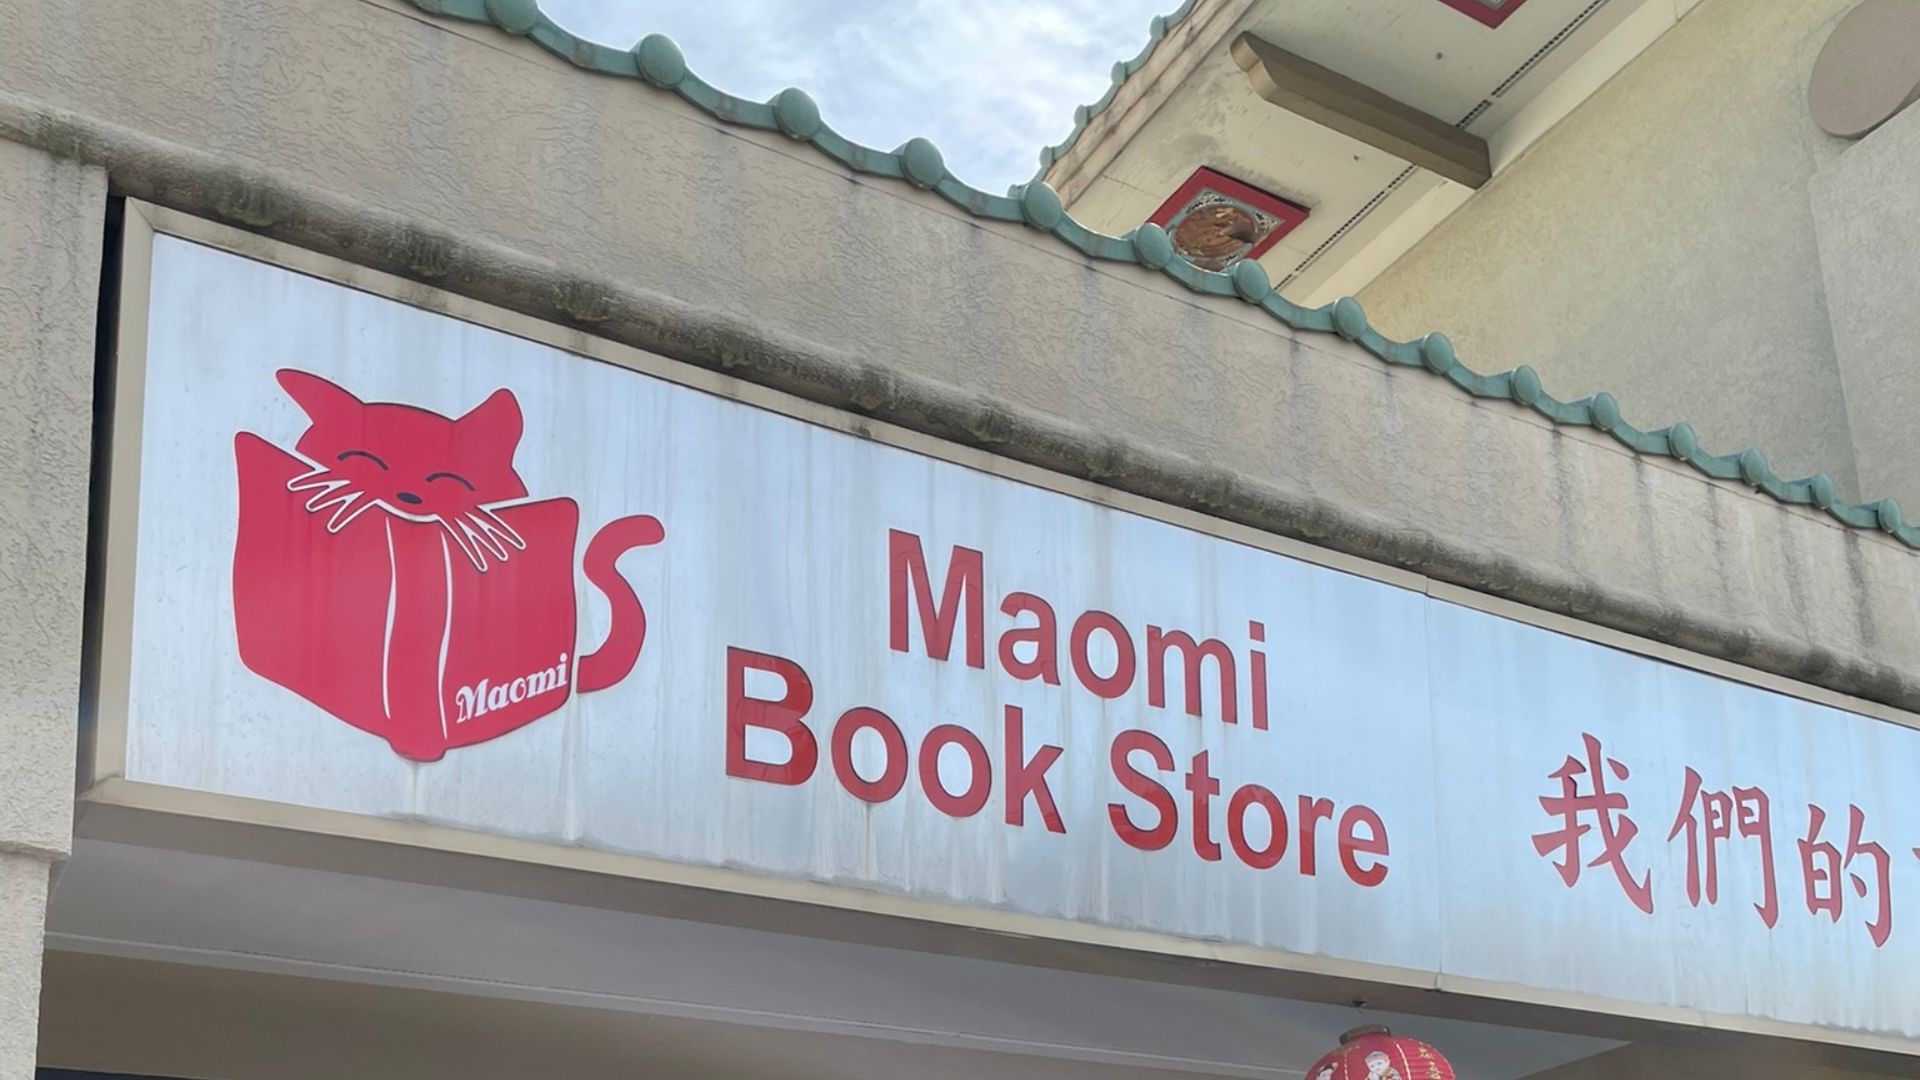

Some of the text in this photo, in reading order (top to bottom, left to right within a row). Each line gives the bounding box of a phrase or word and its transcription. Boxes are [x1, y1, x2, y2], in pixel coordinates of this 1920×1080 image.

[455, 652, 568, 724] Maomi
[888, 527, 1268, 731] Maomi
[726, 646, 1390, 888] Book Store
[1531, 732, 1920, 948] 我們的
